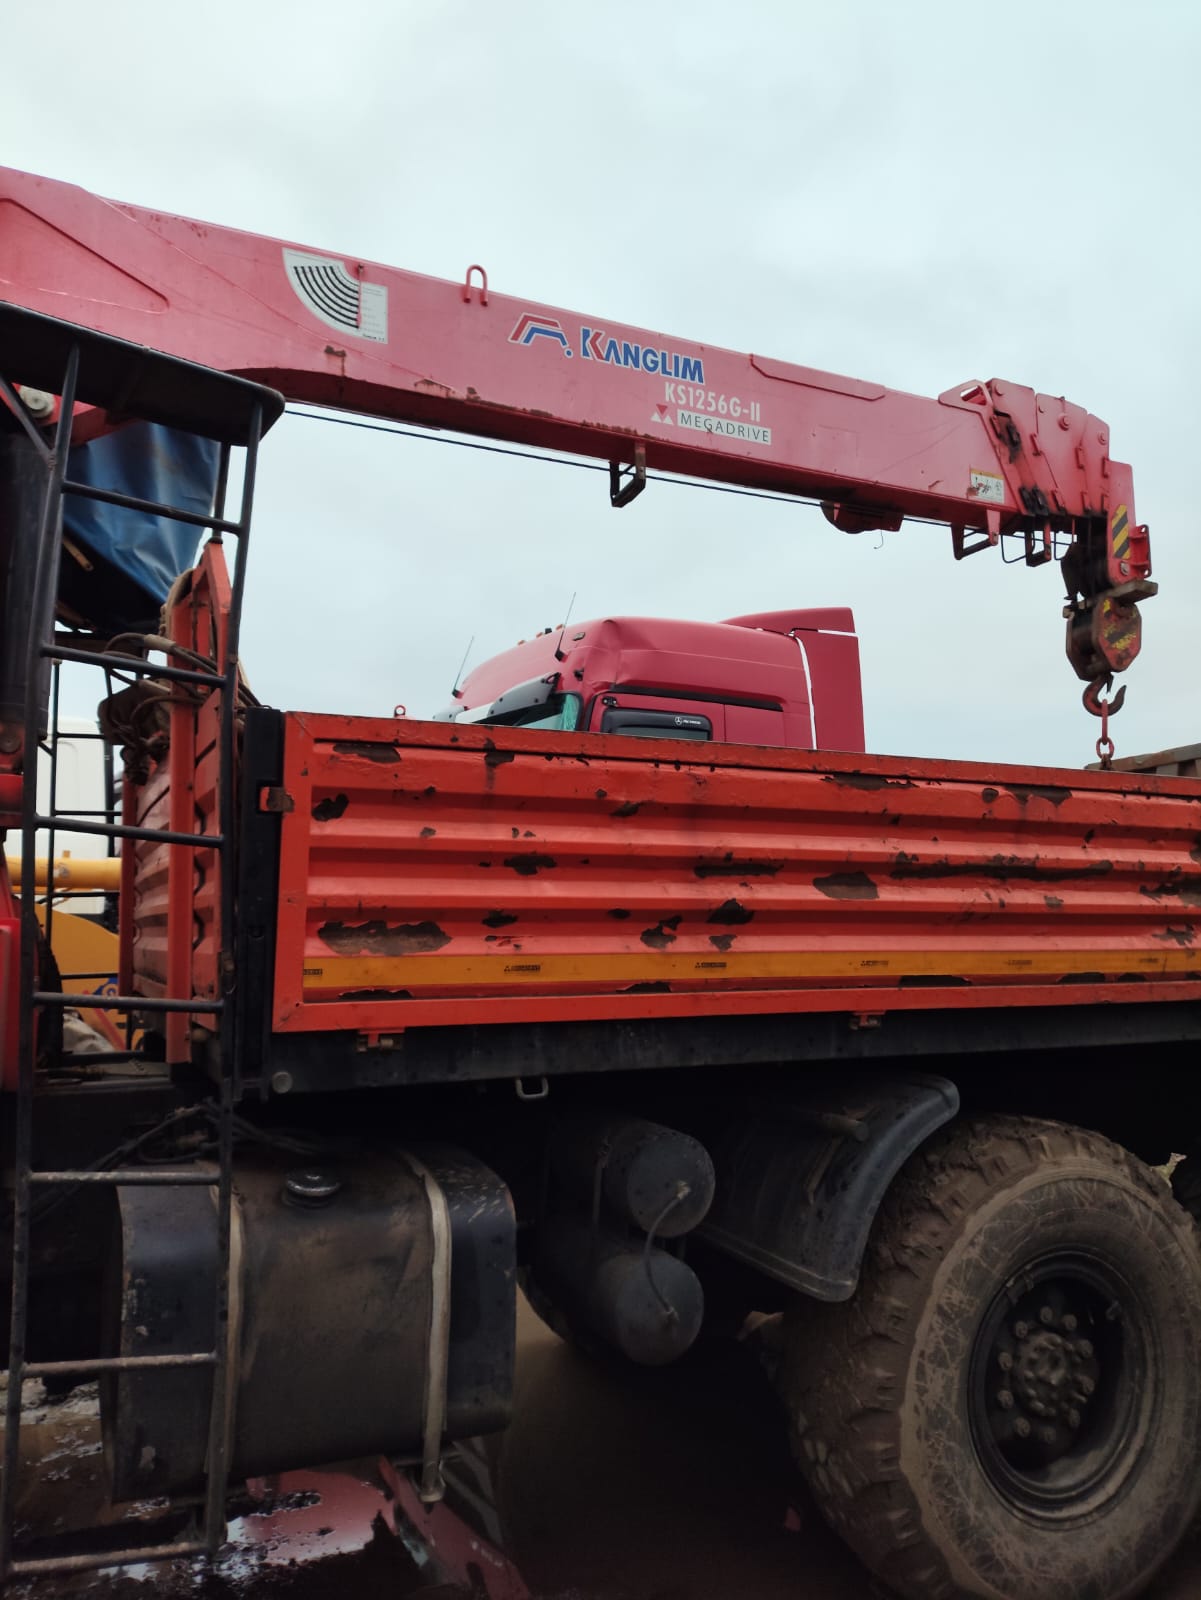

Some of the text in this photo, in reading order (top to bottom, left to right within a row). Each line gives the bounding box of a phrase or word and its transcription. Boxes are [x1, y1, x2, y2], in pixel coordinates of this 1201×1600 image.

[581, 327, 704, 384] KANGLIM
[665, 382, 761, 421] KS1256G-II
[680, 413, 769, 442] MEGADRIVE
